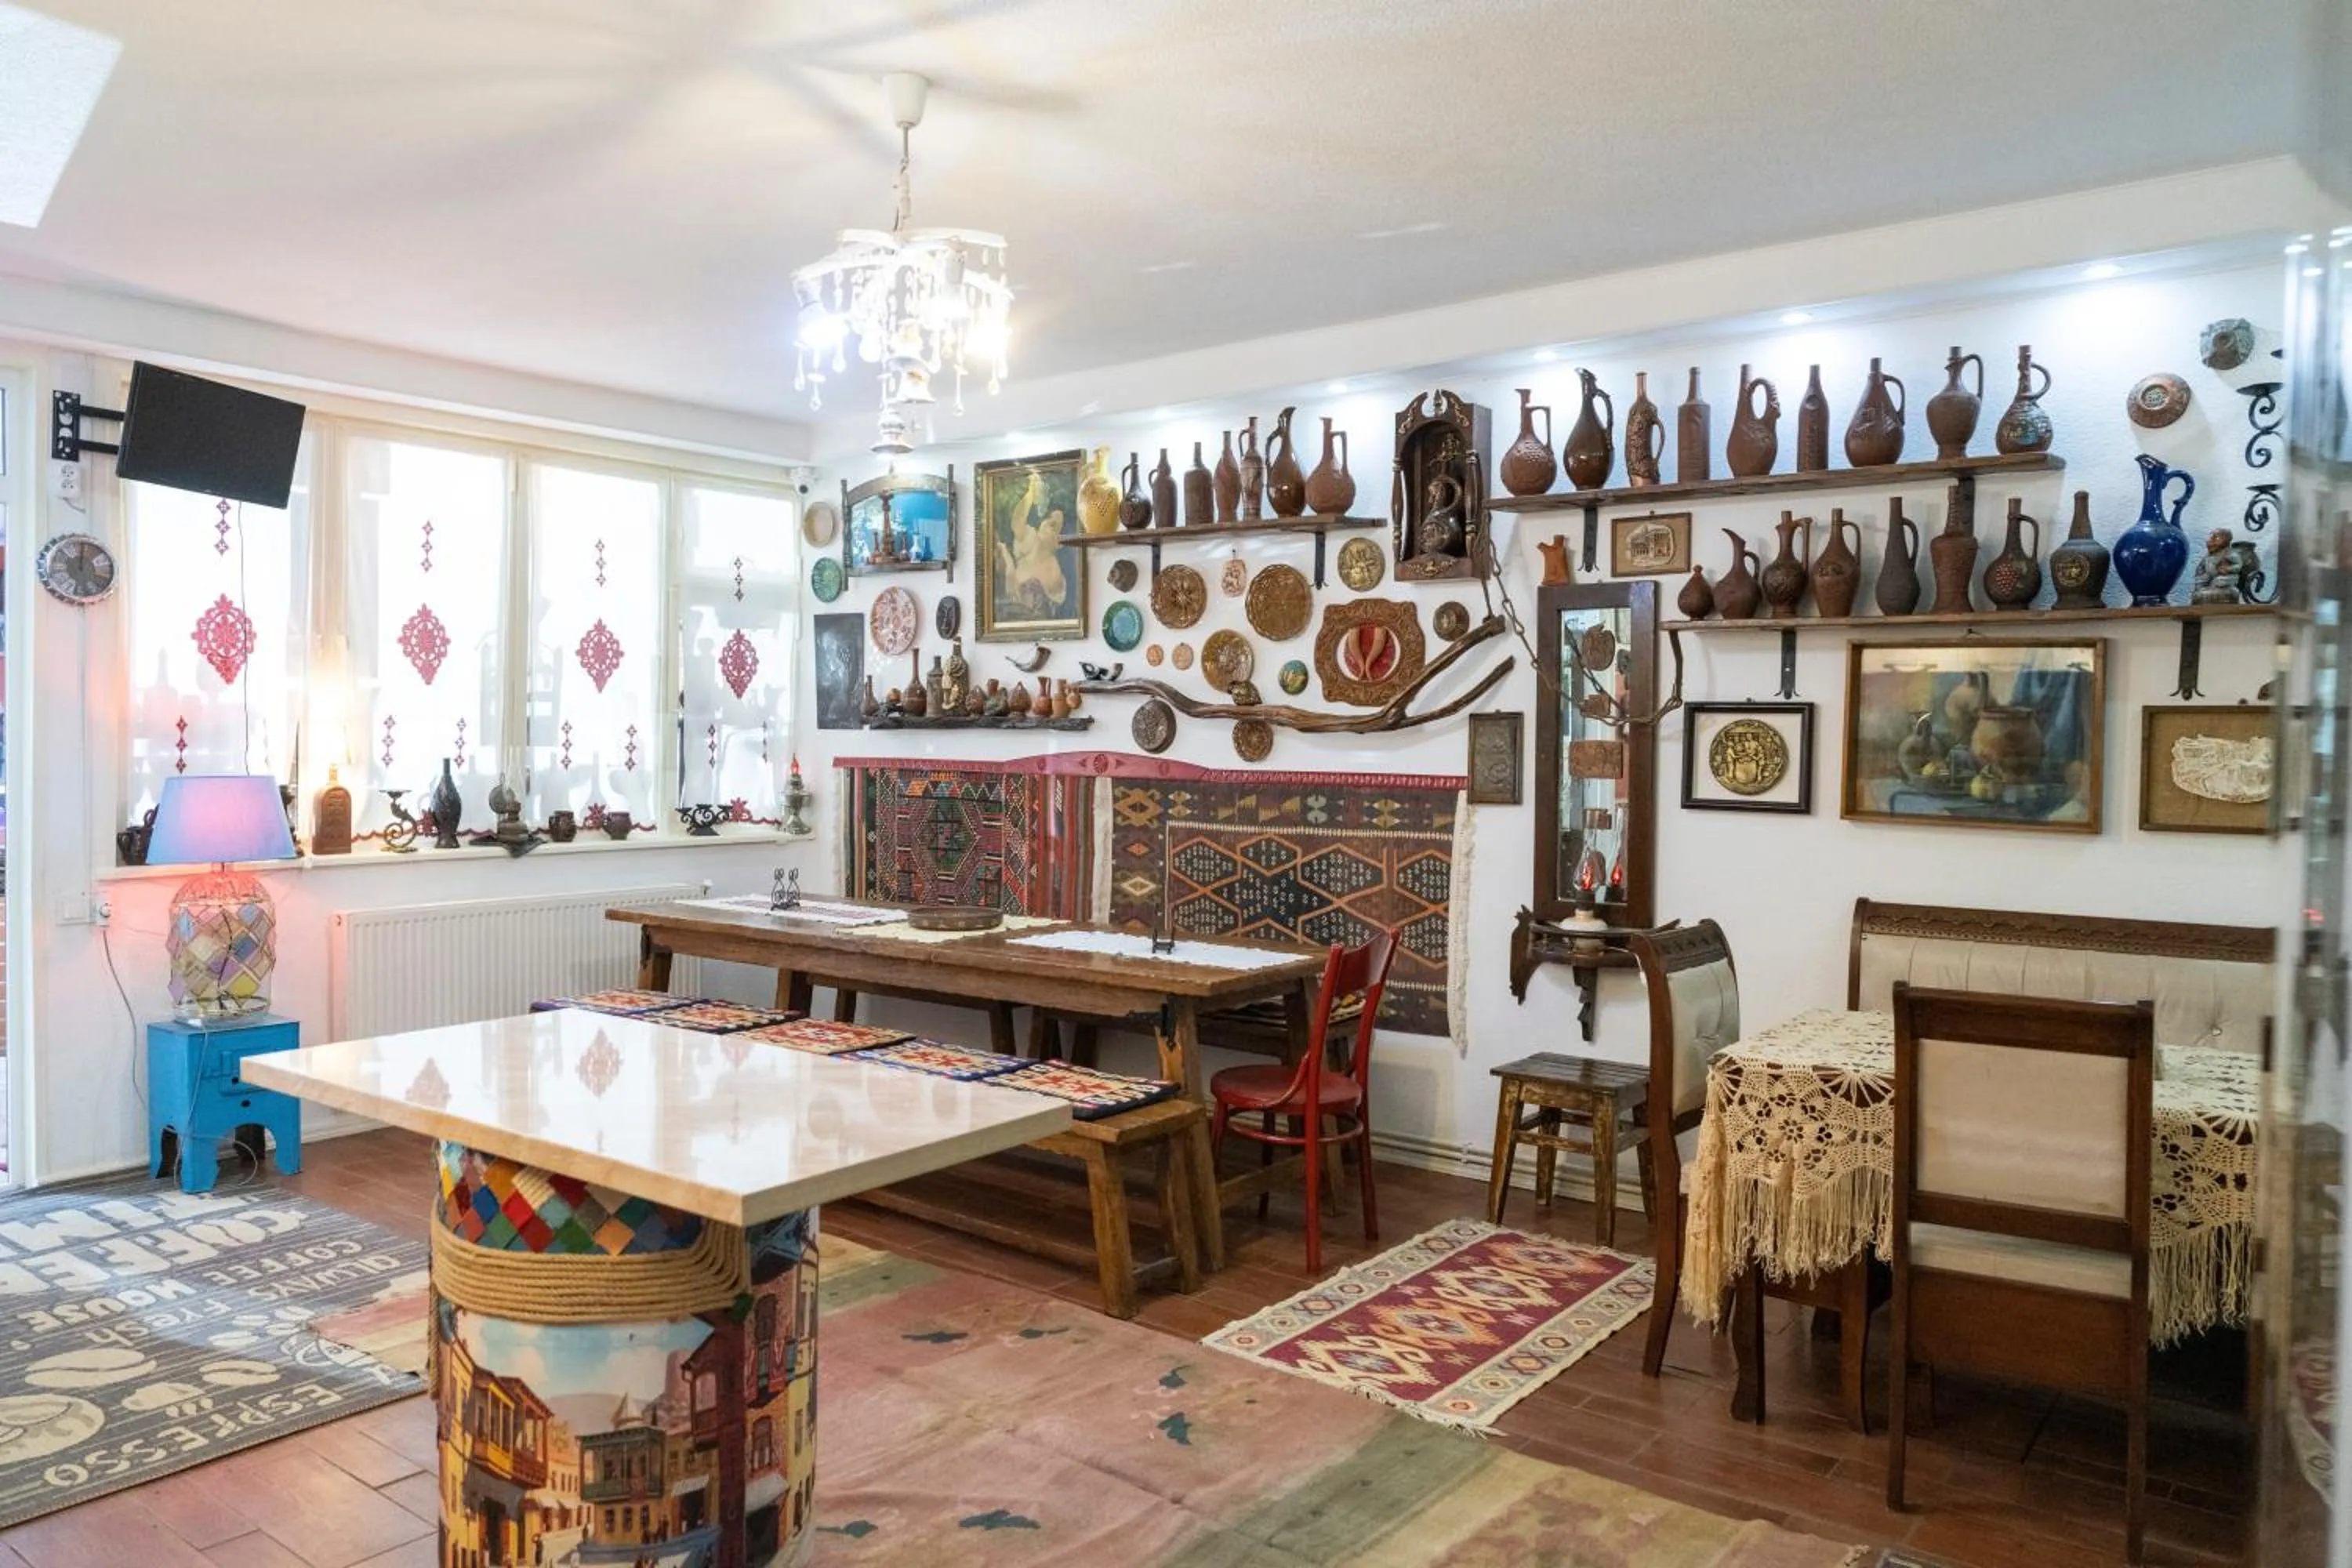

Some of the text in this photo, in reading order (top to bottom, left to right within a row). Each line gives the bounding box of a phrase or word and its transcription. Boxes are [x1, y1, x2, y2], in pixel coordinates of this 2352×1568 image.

[0, 1192, 260, 1256] TIM
[17, 1241, 362, 1333] COFFEE HOUSE
